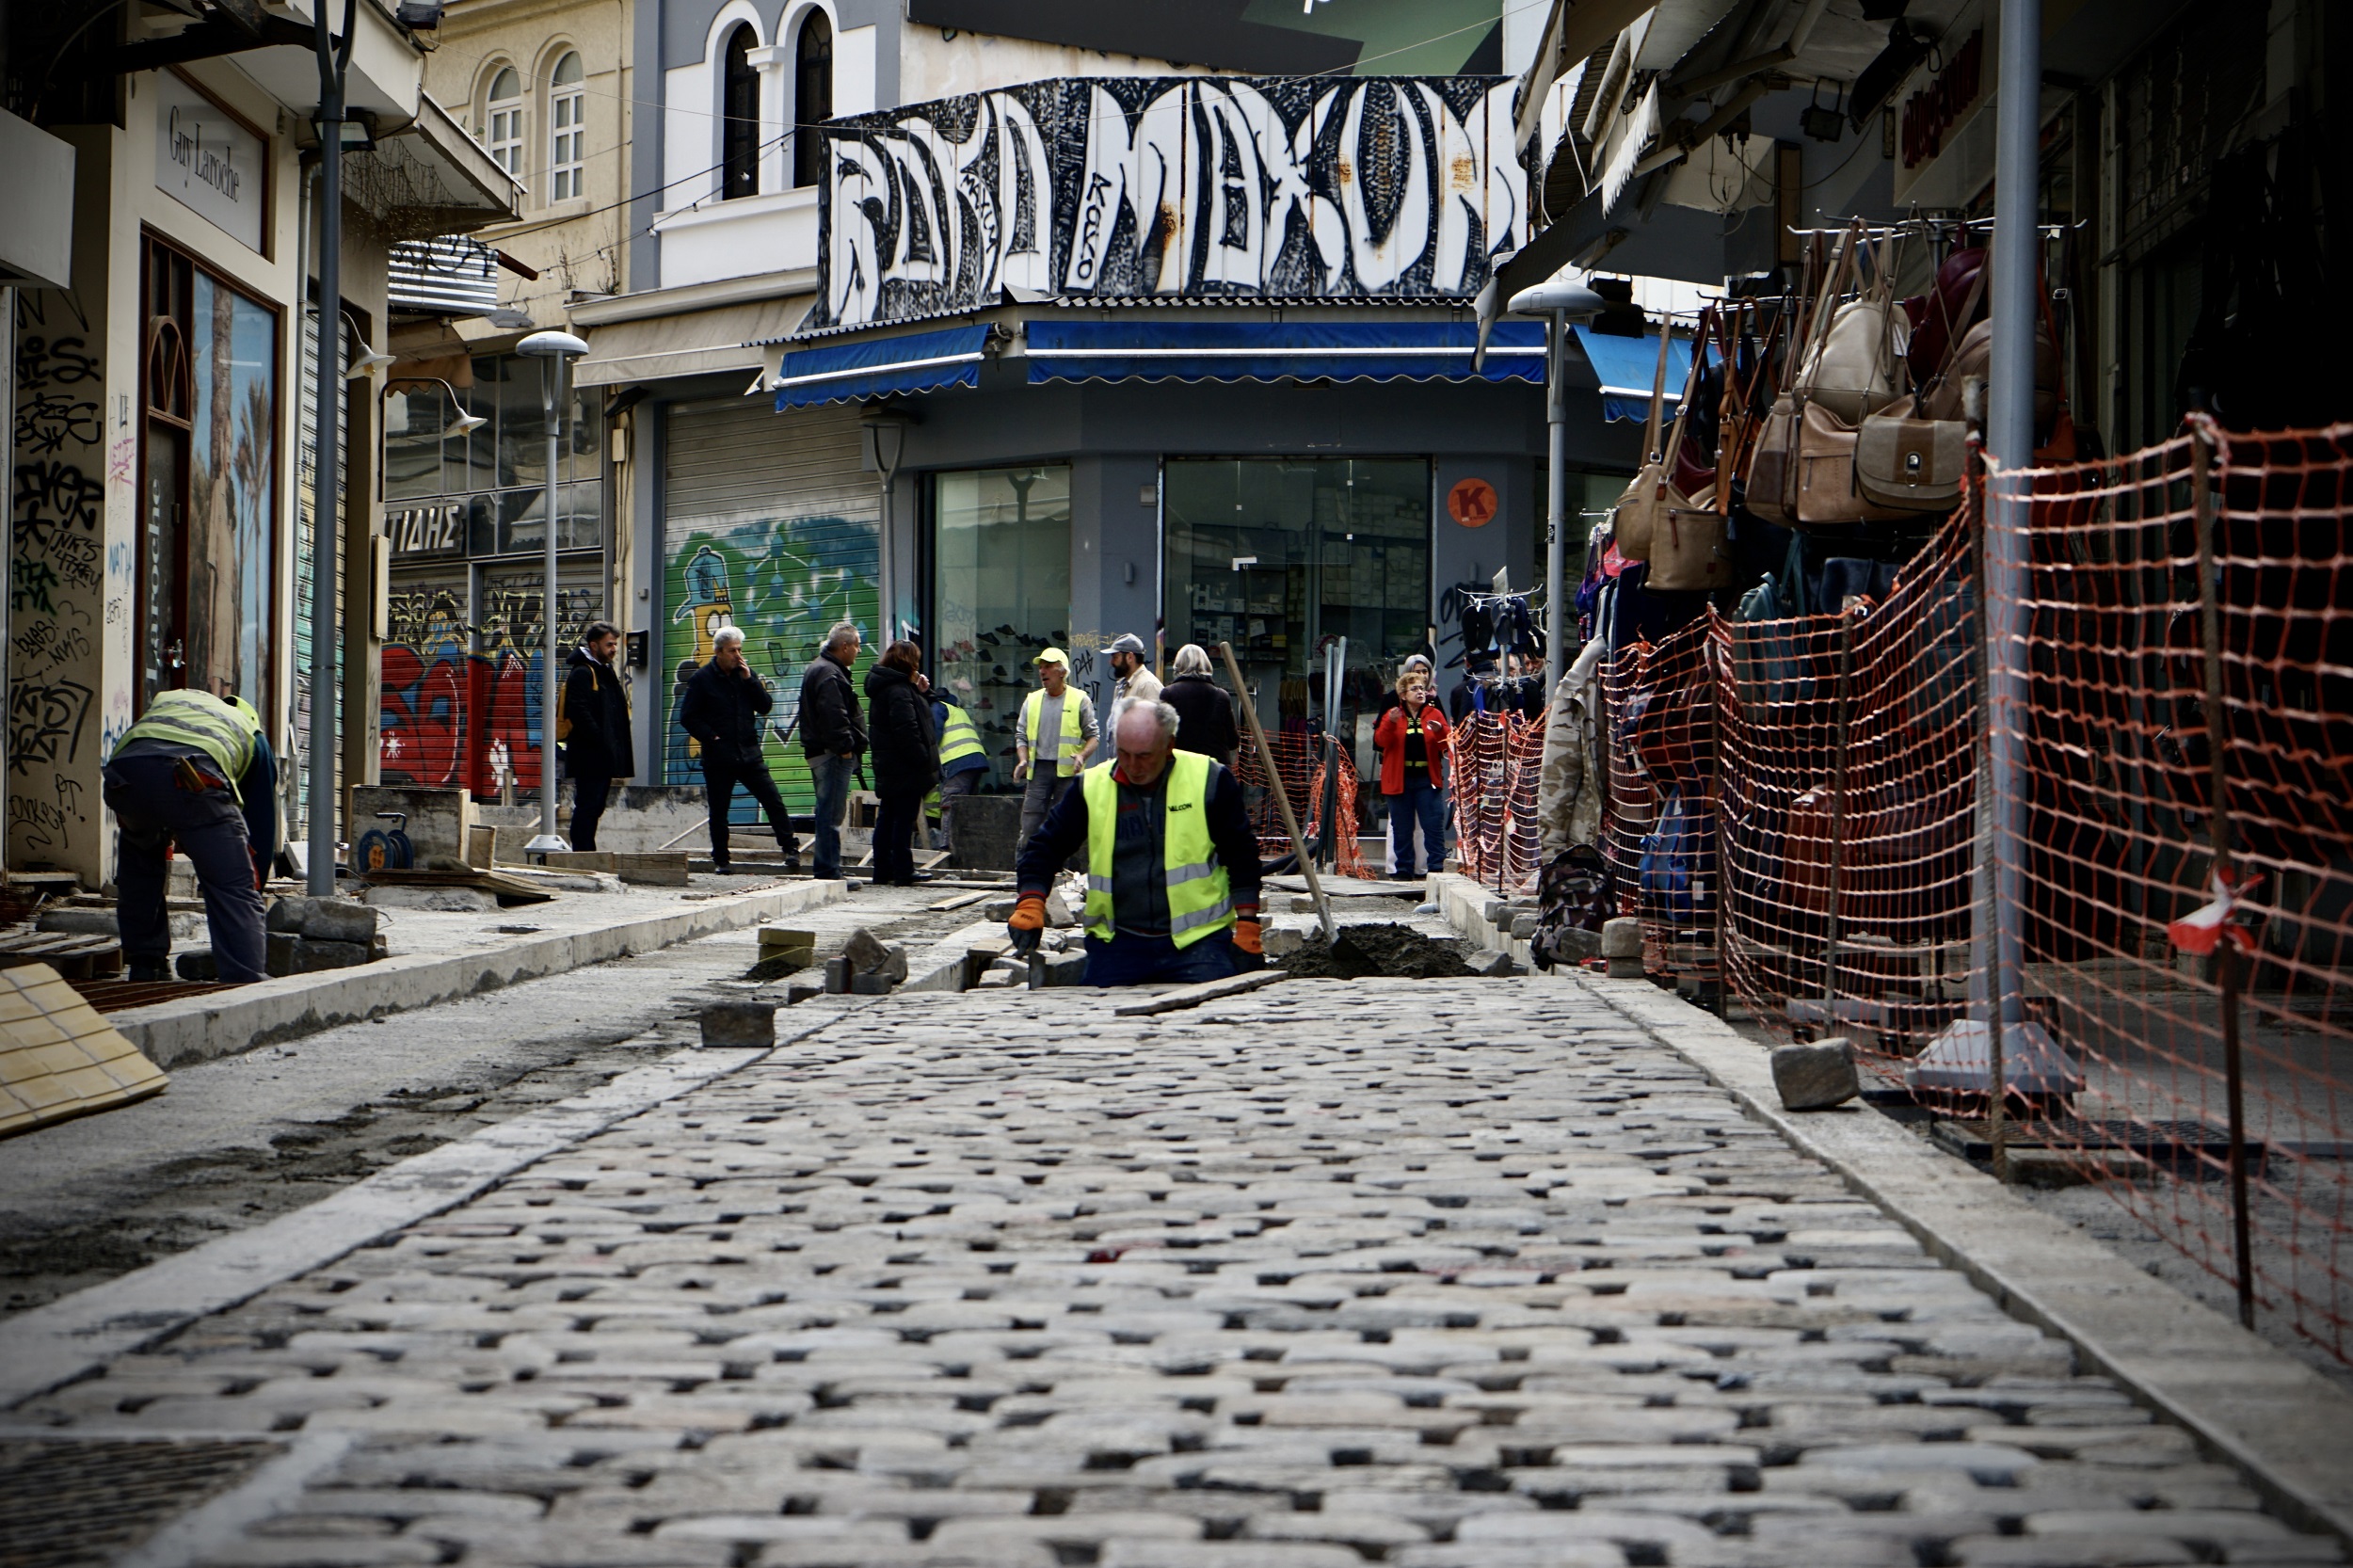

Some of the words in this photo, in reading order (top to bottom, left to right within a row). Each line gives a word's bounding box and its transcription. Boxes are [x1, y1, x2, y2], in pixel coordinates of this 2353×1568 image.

[169, 105, 193, 188] Guy
[195, 123, 240, 203] Laroche
[384, 505, 459, 552] ΤΙΔΗΣ
